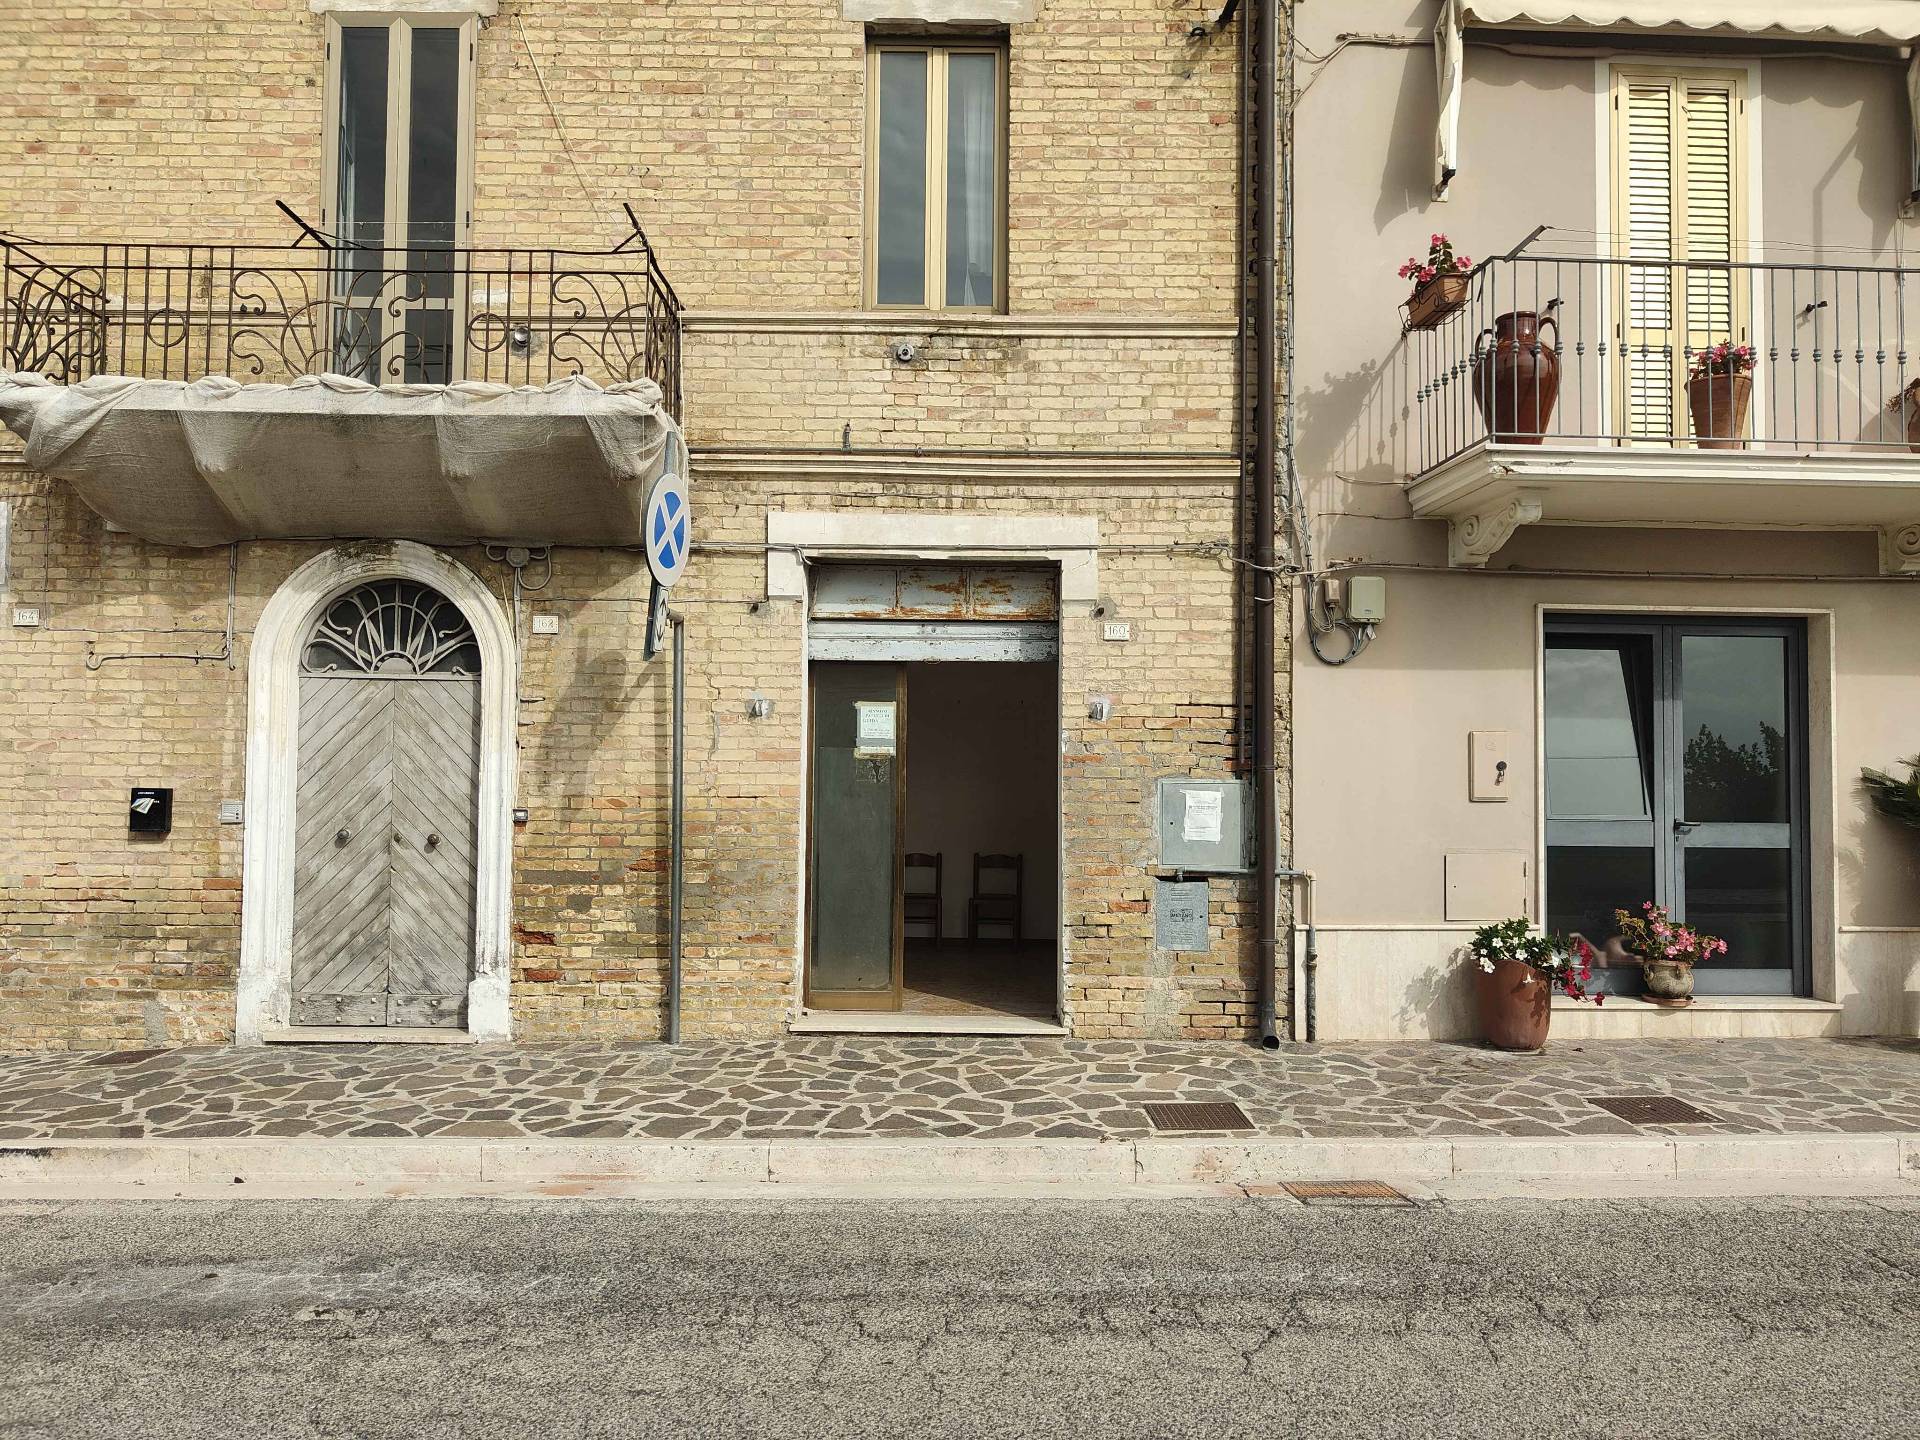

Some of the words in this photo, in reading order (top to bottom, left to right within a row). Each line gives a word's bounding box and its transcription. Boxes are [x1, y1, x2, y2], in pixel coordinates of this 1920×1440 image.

[18, 611, 34, 621] 164
[538, 619, 554, 629] 162
[1109, 625, 1126, 636] 160
